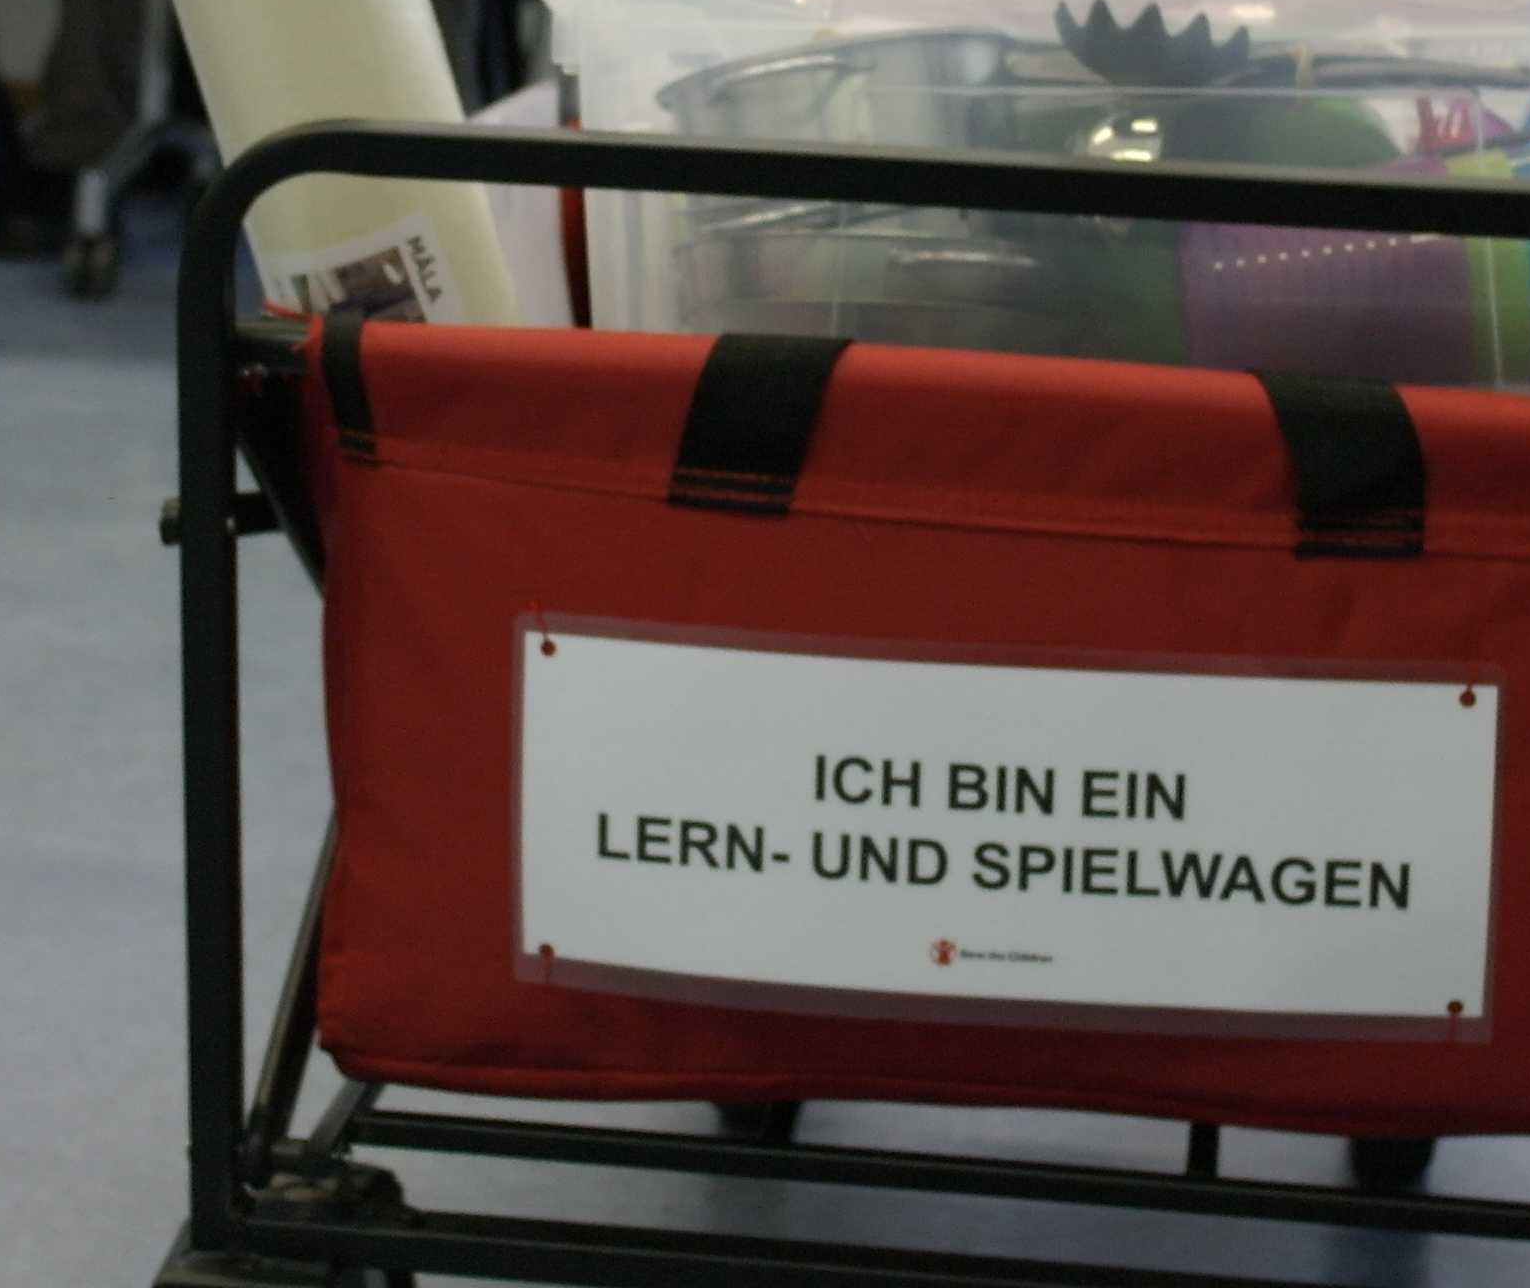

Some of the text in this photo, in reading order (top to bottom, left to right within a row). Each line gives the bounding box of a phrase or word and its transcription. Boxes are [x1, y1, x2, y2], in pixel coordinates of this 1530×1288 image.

[815, 754, 1186, 821] ICH BIN EIN
[597, 812, 1411, 911] LERN- UND SPIELWAGEN
